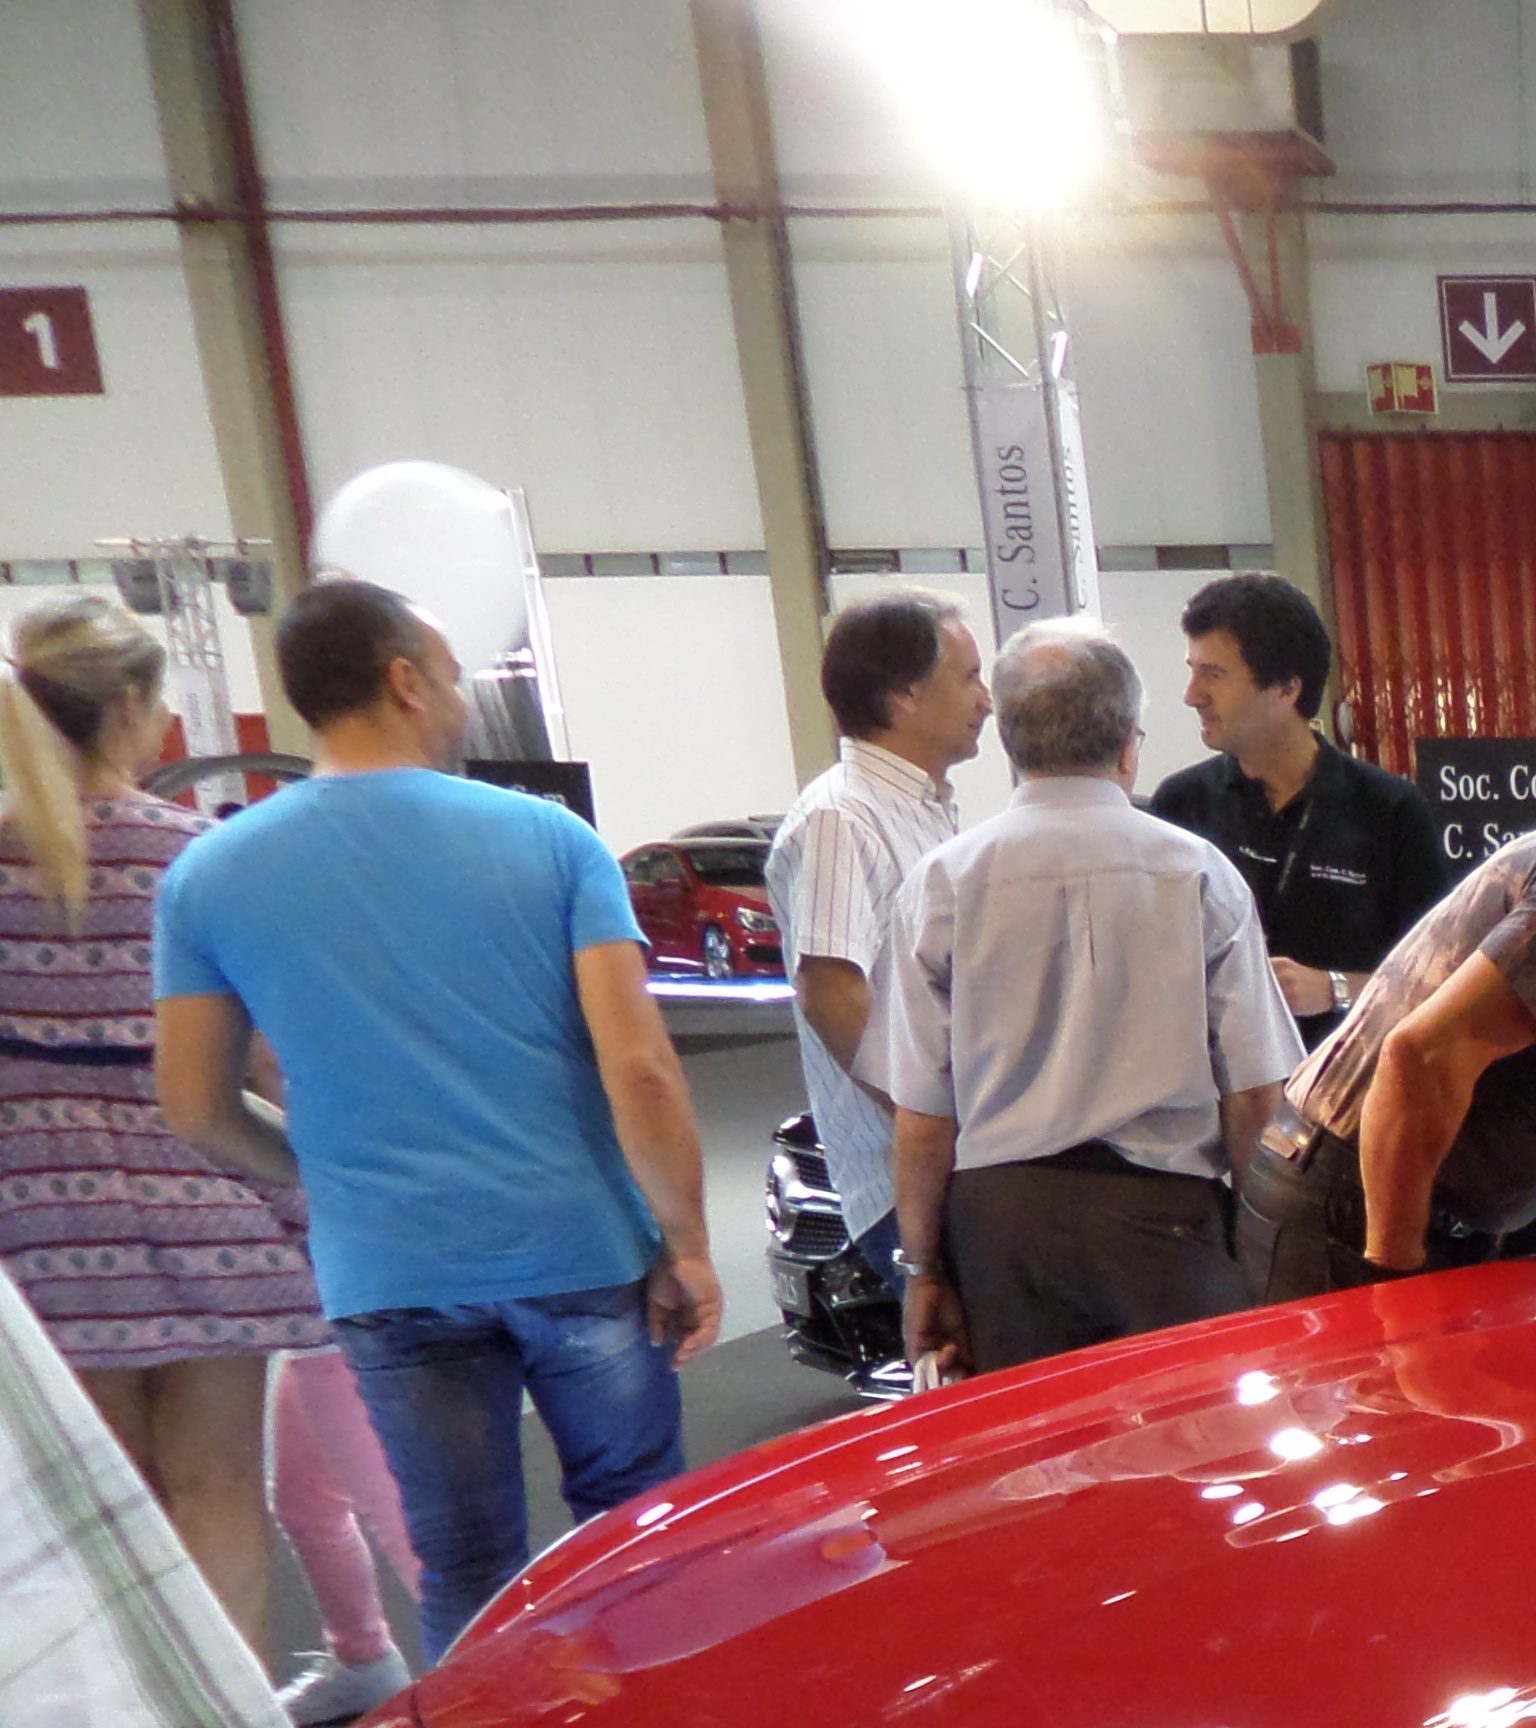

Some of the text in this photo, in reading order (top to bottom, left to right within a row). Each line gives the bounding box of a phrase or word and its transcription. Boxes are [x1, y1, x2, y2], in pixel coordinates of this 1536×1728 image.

[23, 312, 58, 369] 1
[995, 444, 1040, 611] C. Santos
[1440, 765, 1499, 801] Soc.
[1443, 823, 1473, 860] C.
